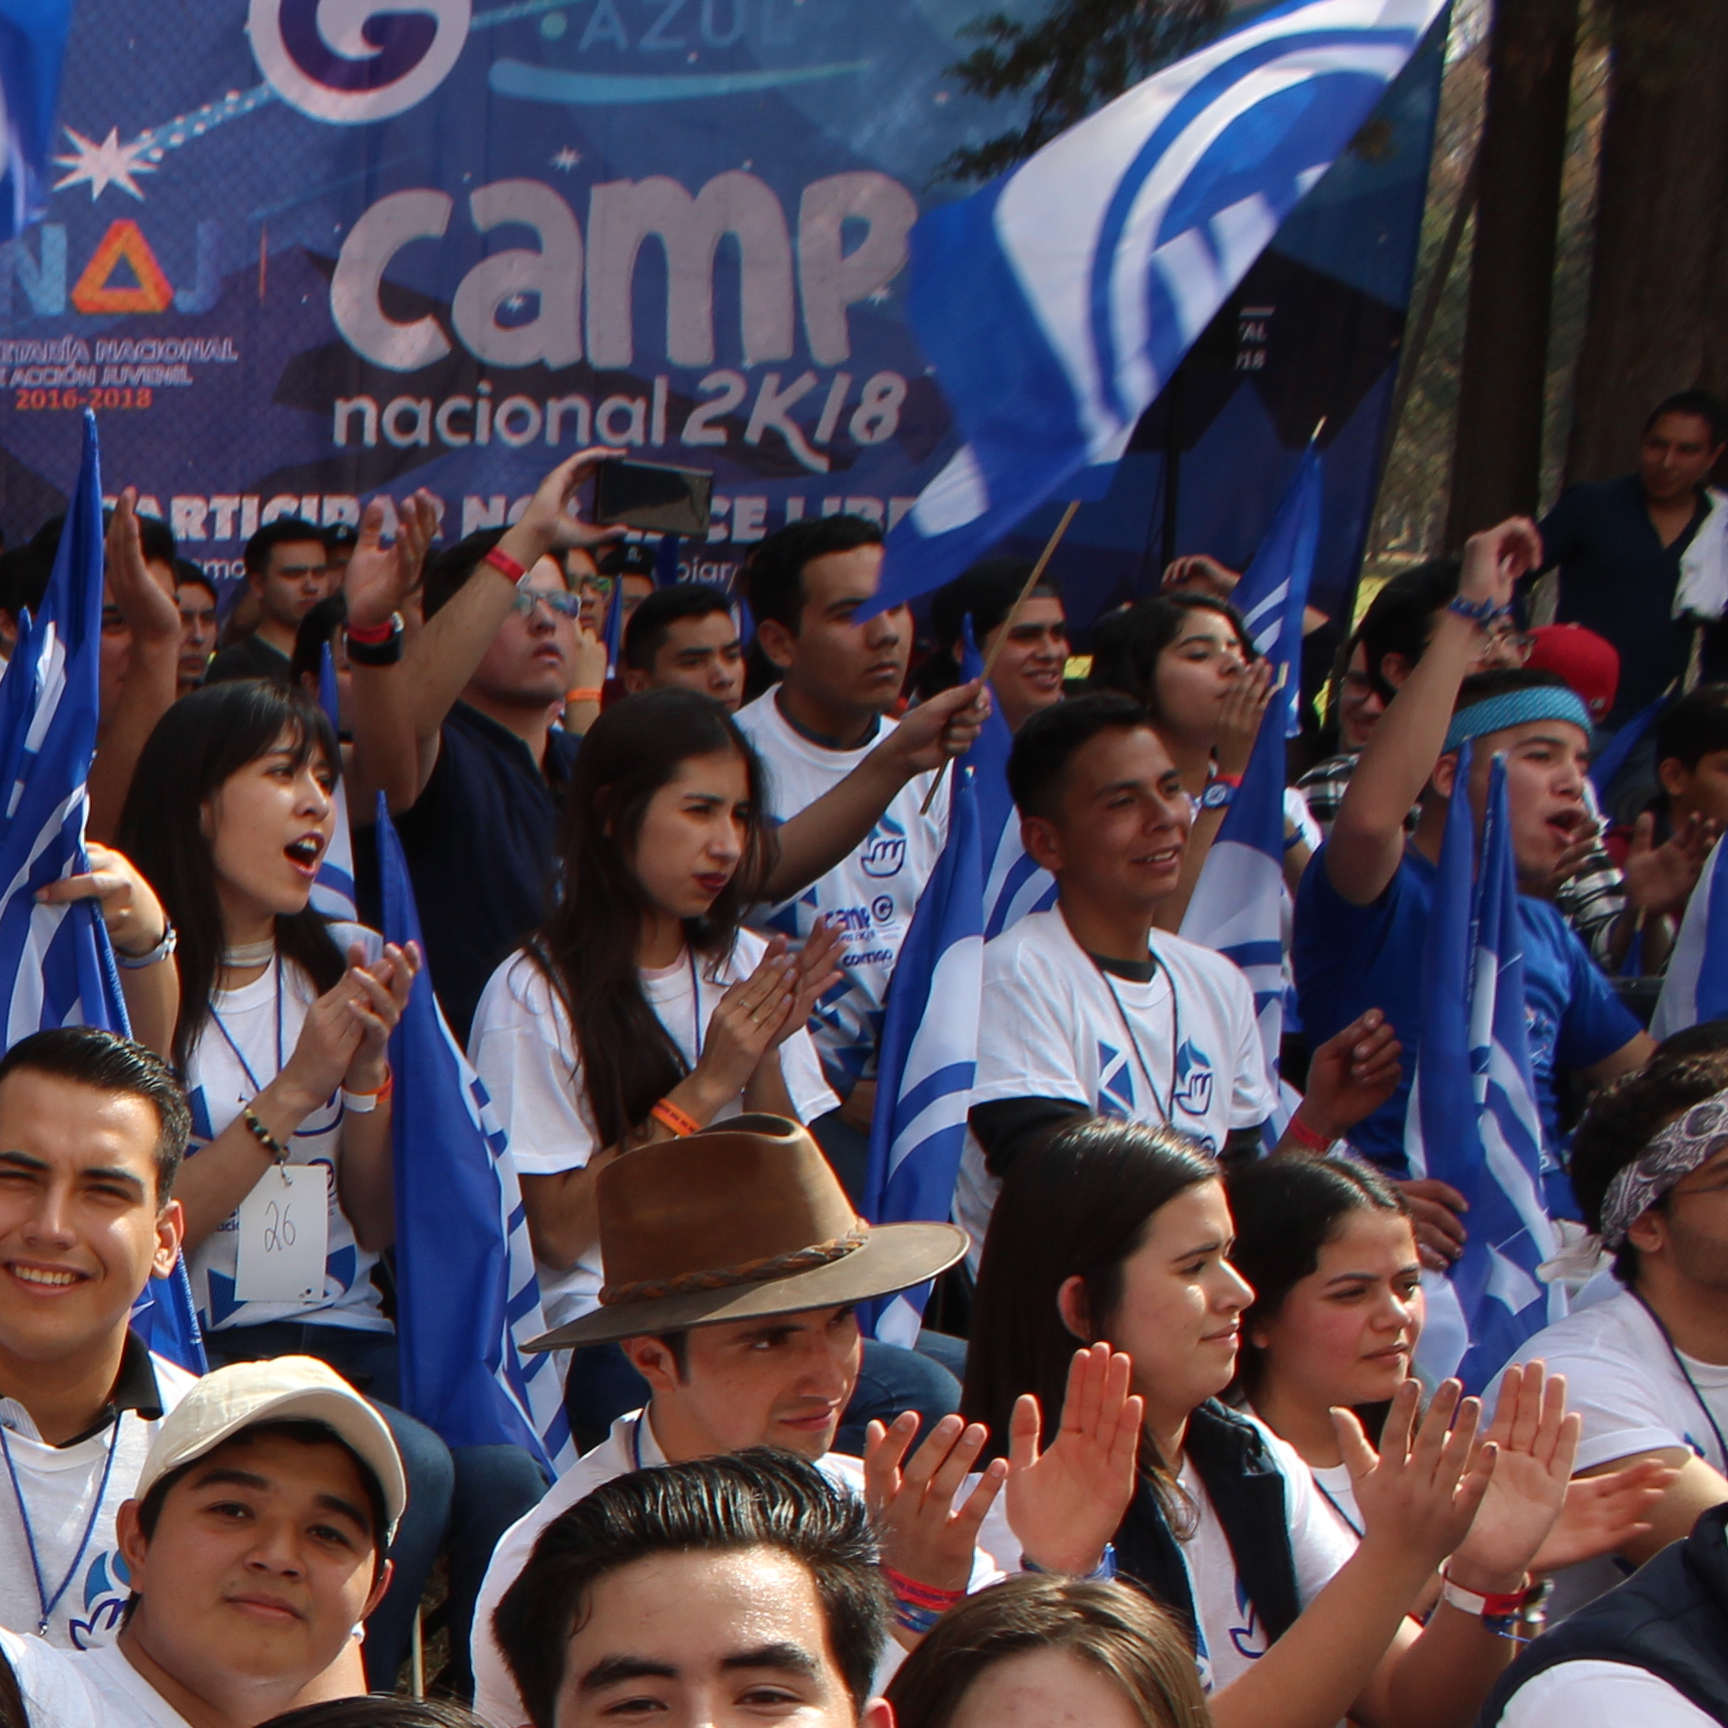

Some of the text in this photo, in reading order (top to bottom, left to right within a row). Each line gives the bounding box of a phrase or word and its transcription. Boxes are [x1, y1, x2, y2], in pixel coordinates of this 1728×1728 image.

[96, 337, 239, 363] NACIONAL
[102, 364, 194, 387] JUVENIL
[15, 388, 153, 410] 2016-2018
[333, 380, 668, 446] nacional
[264, 1200, 296, 1252] 26
